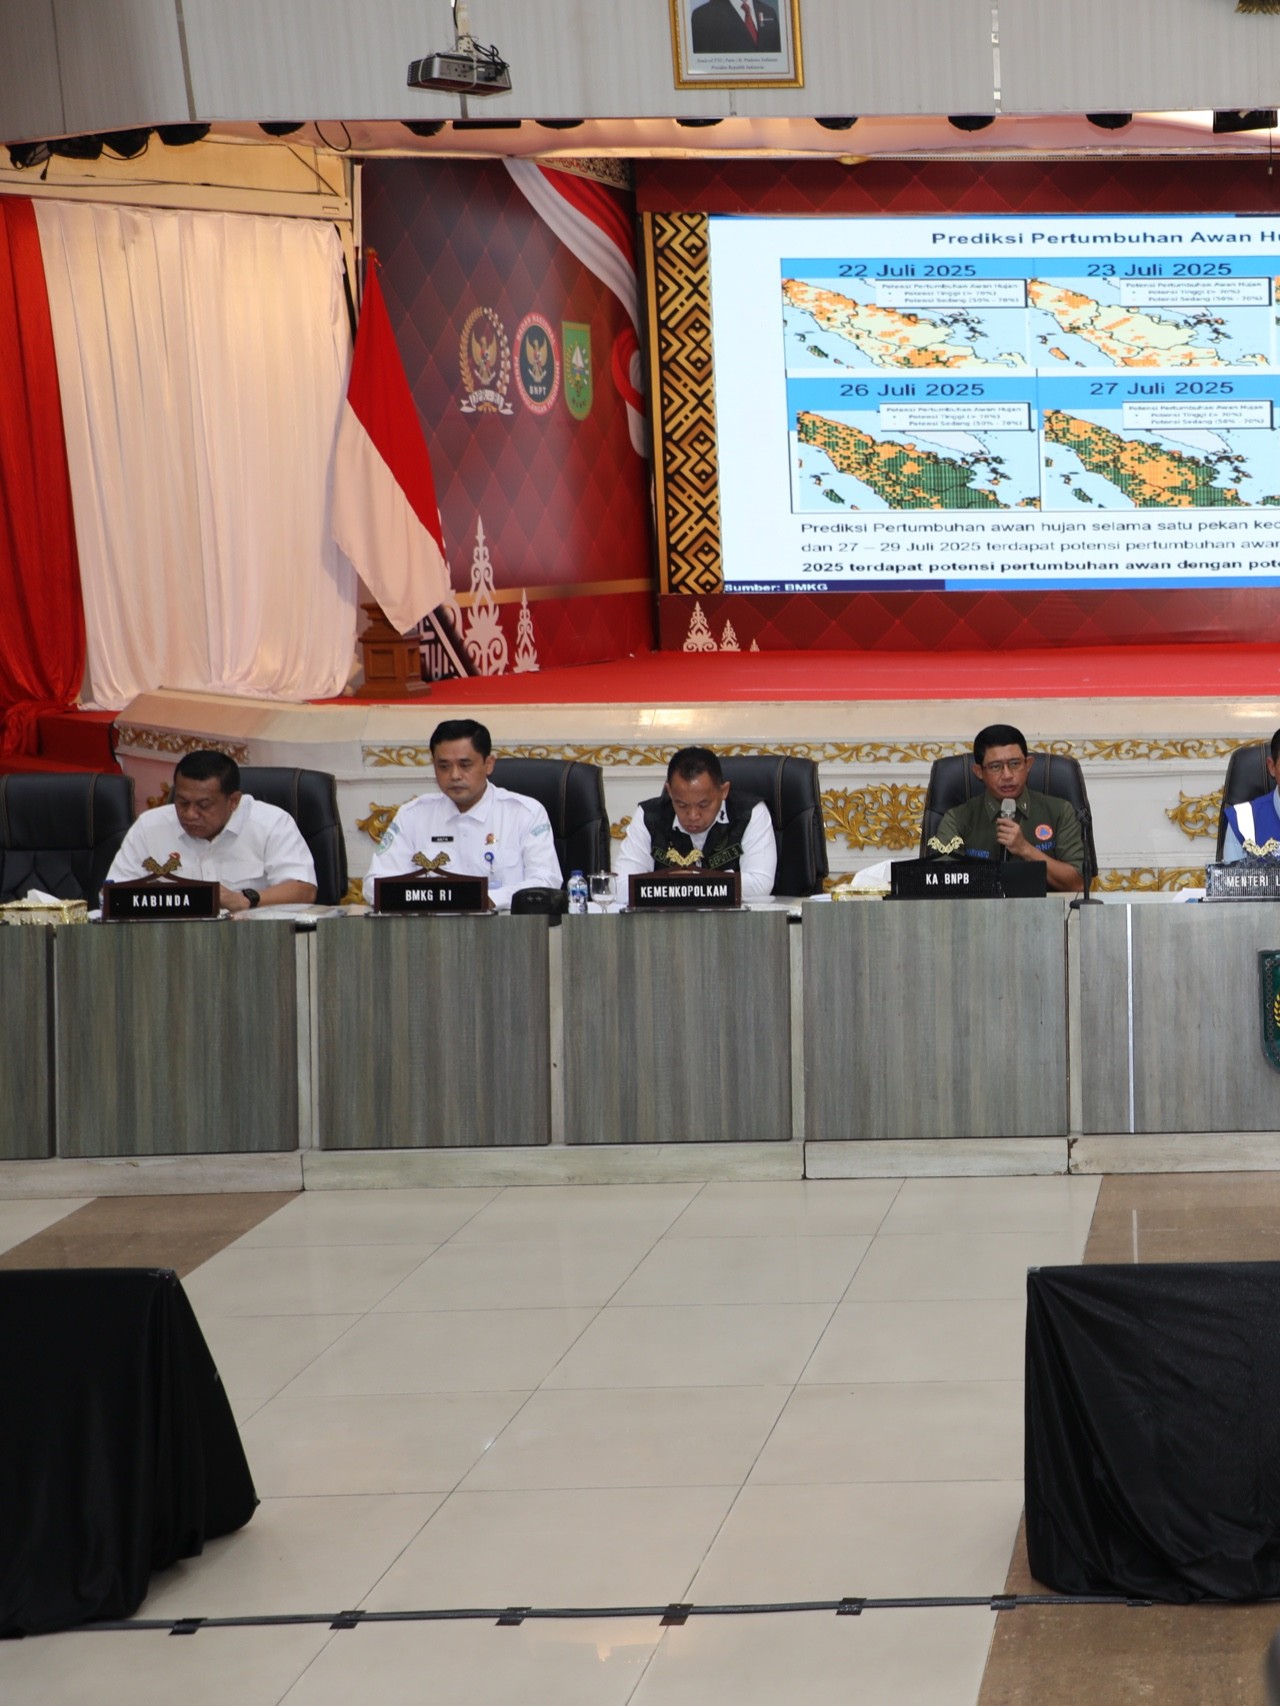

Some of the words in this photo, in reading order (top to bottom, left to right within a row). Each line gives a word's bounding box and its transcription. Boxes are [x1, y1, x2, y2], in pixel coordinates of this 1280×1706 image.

[932, 233, 1023, 244] Prediksi
[1032, 232, 1183, 244] Pertumbuhan
[1190, 232, 1251, 243] Awan
[839, 264, 867, 277] 22
[876, 264, 915, 277] Juli
[924, 265, 976, 277] 2025
[1087, 264, 1116, 277] 23
[1124, 264, 1162, 276] Juli
[1173, 263, 1232, 276] 2025
[840, 384, 869, 396] 26
[877, 384, 915, 396] Juli
[926, 383, 984, 396] 2025
[1090, 382, 1119, 395] 27
[1127, 382, 1165, 395] Juli
[1175, 382, 1234, 394] 2025
[801, 523, 867, 533] Prediksi
[873, 523, 985, 532] Pertumbuhan
[991, 524, 1035, 532] awan
[1041, 522, 1086, 534] hujan
[1092, 522, 1151, 531] selama
[1157, 521, 1192, 530] satu
[1198, 520, 1248, 532] pekan
[801, 543, 833, 552] dan
[838, 542, 859, 552] 27
[880, 542, 901, 552] 29
[906, 542, 934, 552] Juli
[940, 542, 981, 552] 2025
[986, 541, 1055, 553] terdapat
[1060, 541, 1120, 553] potensi
[1126, 539, 1236, 552] pertumbuhan
[803, 563, 844, 572] 2025
[849, 562, 922, 574] terdapat
[929, 562, 995, 573] potensi
[1001, 561, 1119, 573] pertumbuhan
[1177, 560, 1242, 571] dengan
[724, 584, 780, 594] Sumber:
[784, 583, 828, 593] BMKG
[708, 850, 731, 868] DEPUTI
[926, 873, 938, 885] KA
[944, 873, 969, 885] BNPB
[1226, 876, 1268, 887] MENTERI
[405, 889, 433, 901] BMKG
[439, 889, 452, 901] RI
[641, 885, 727, 898] KEMENKOPOLKAM
[133, 894, 190, 907] KABINDA
